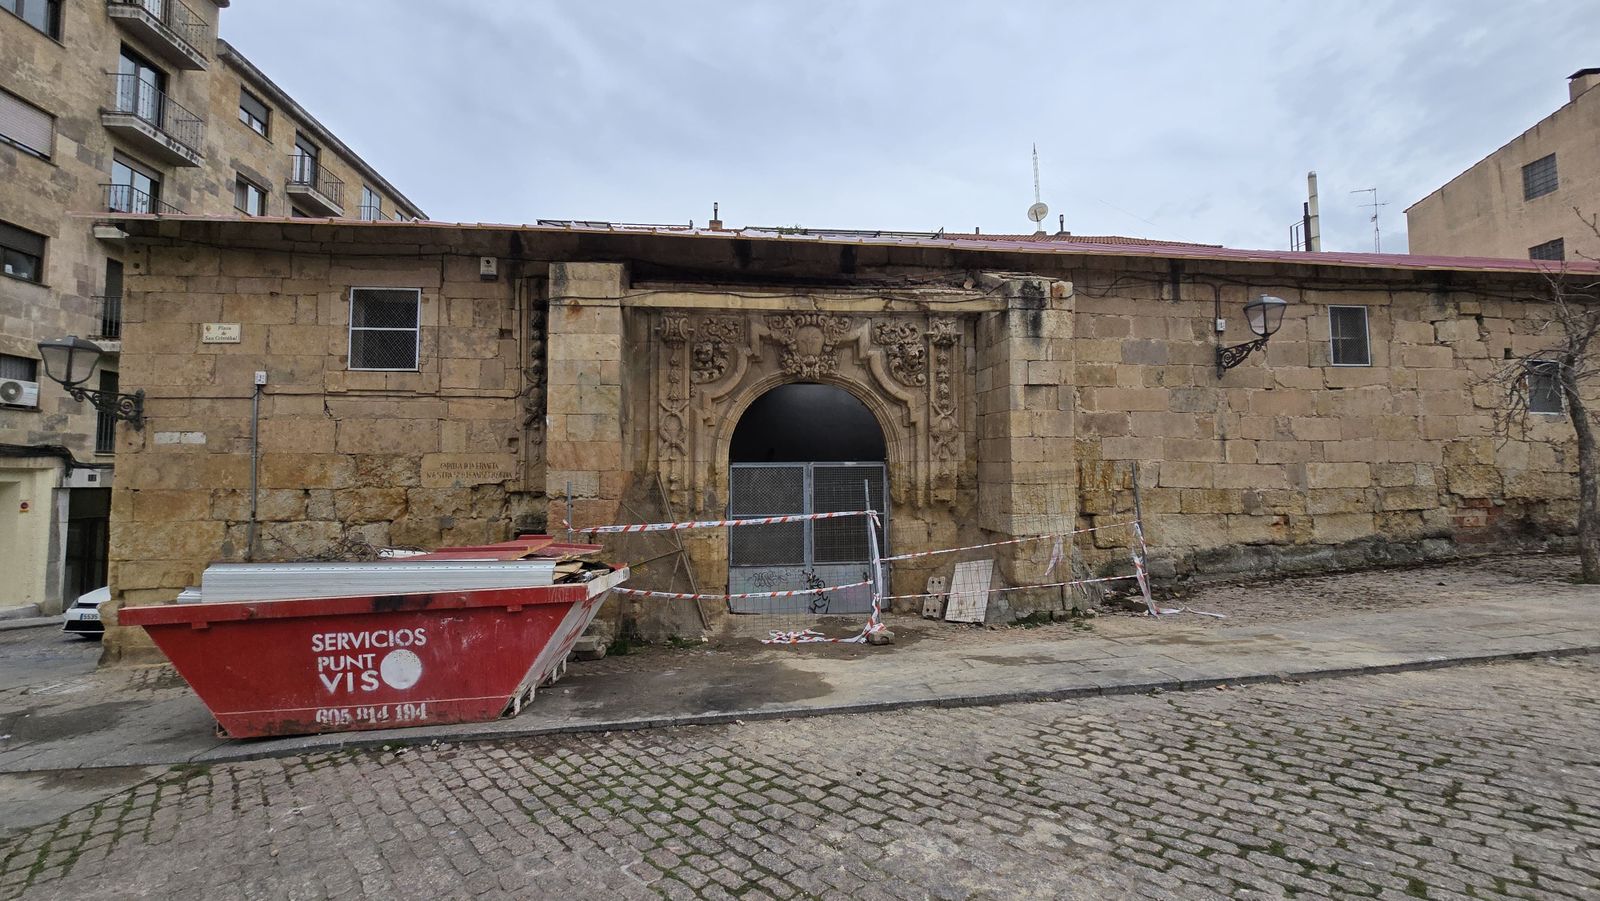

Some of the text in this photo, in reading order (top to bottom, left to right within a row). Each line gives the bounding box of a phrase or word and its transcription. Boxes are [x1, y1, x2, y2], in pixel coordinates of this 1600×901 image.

[311, 627, 427, 653] SERVICIOS
[316, 708, 352, 726] 605
[395, 702, 428, 720] 194
